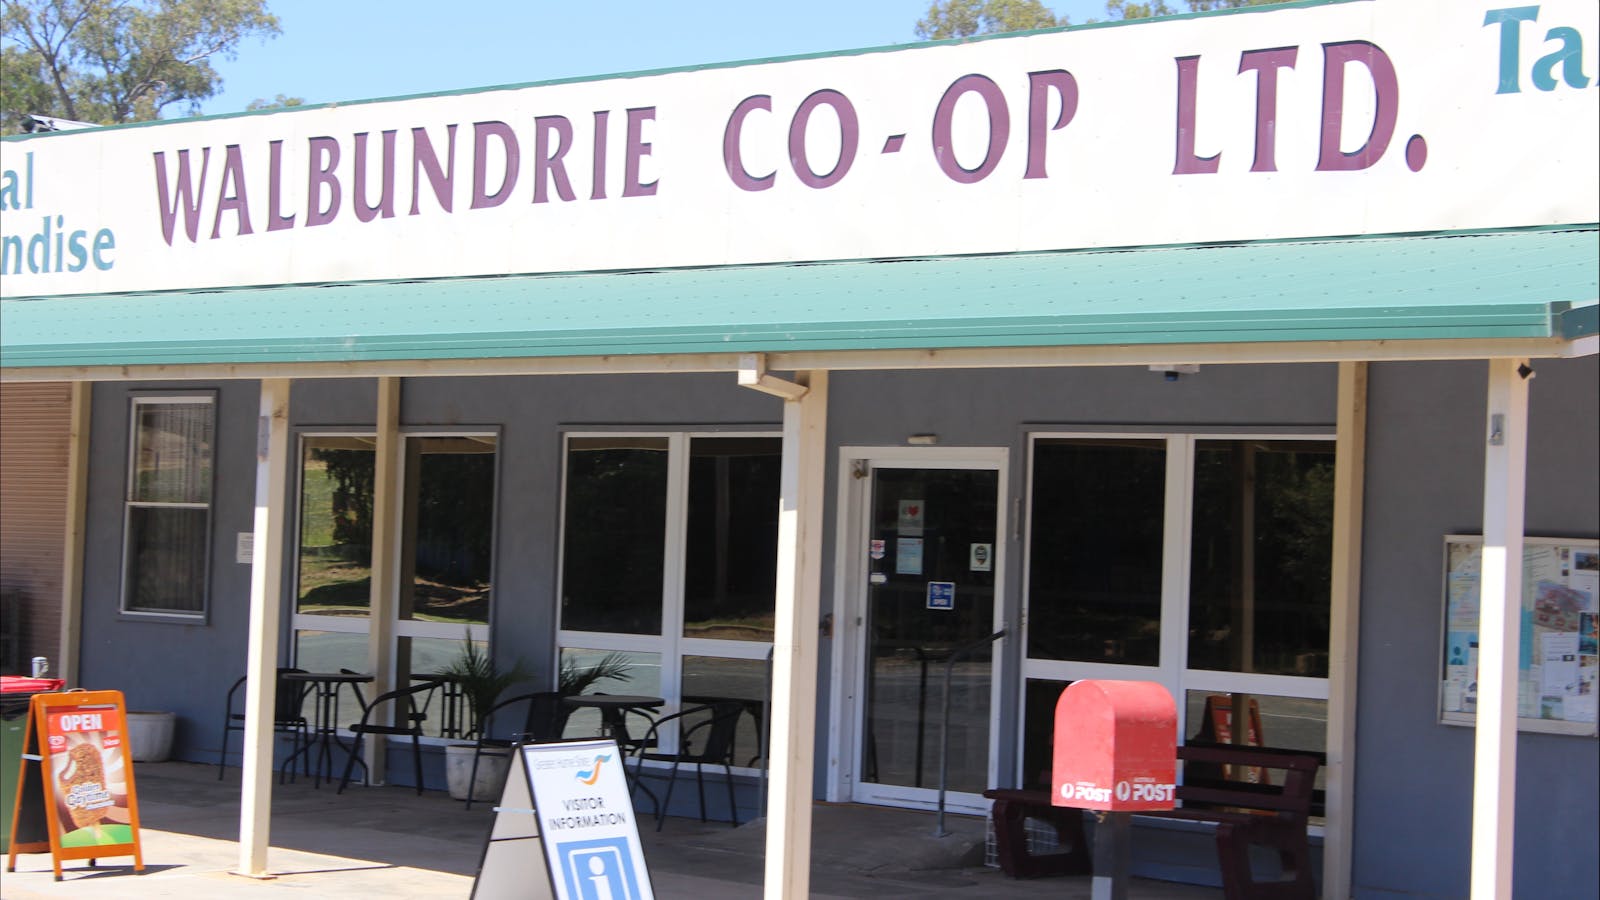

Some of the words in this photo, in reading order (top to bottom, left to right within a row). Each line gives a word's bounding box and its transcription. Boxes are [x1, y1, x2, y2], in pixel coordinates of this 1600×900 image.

[1482, 5, 1599, 95] Ta
[152, 106, 660, 247] WALBUNDRIE
[1171, 39, 1428, 176] LTD.
[1, 214, 116, 275] ndise
[60, 713, 103, 732] OPEN
[1075, 786, 1112, 802] POST
[1133, 784, 1176, 801] POST
[562, 797, 605, 811] VISITOR
[549, 813, 626, 831] INFORMATION
